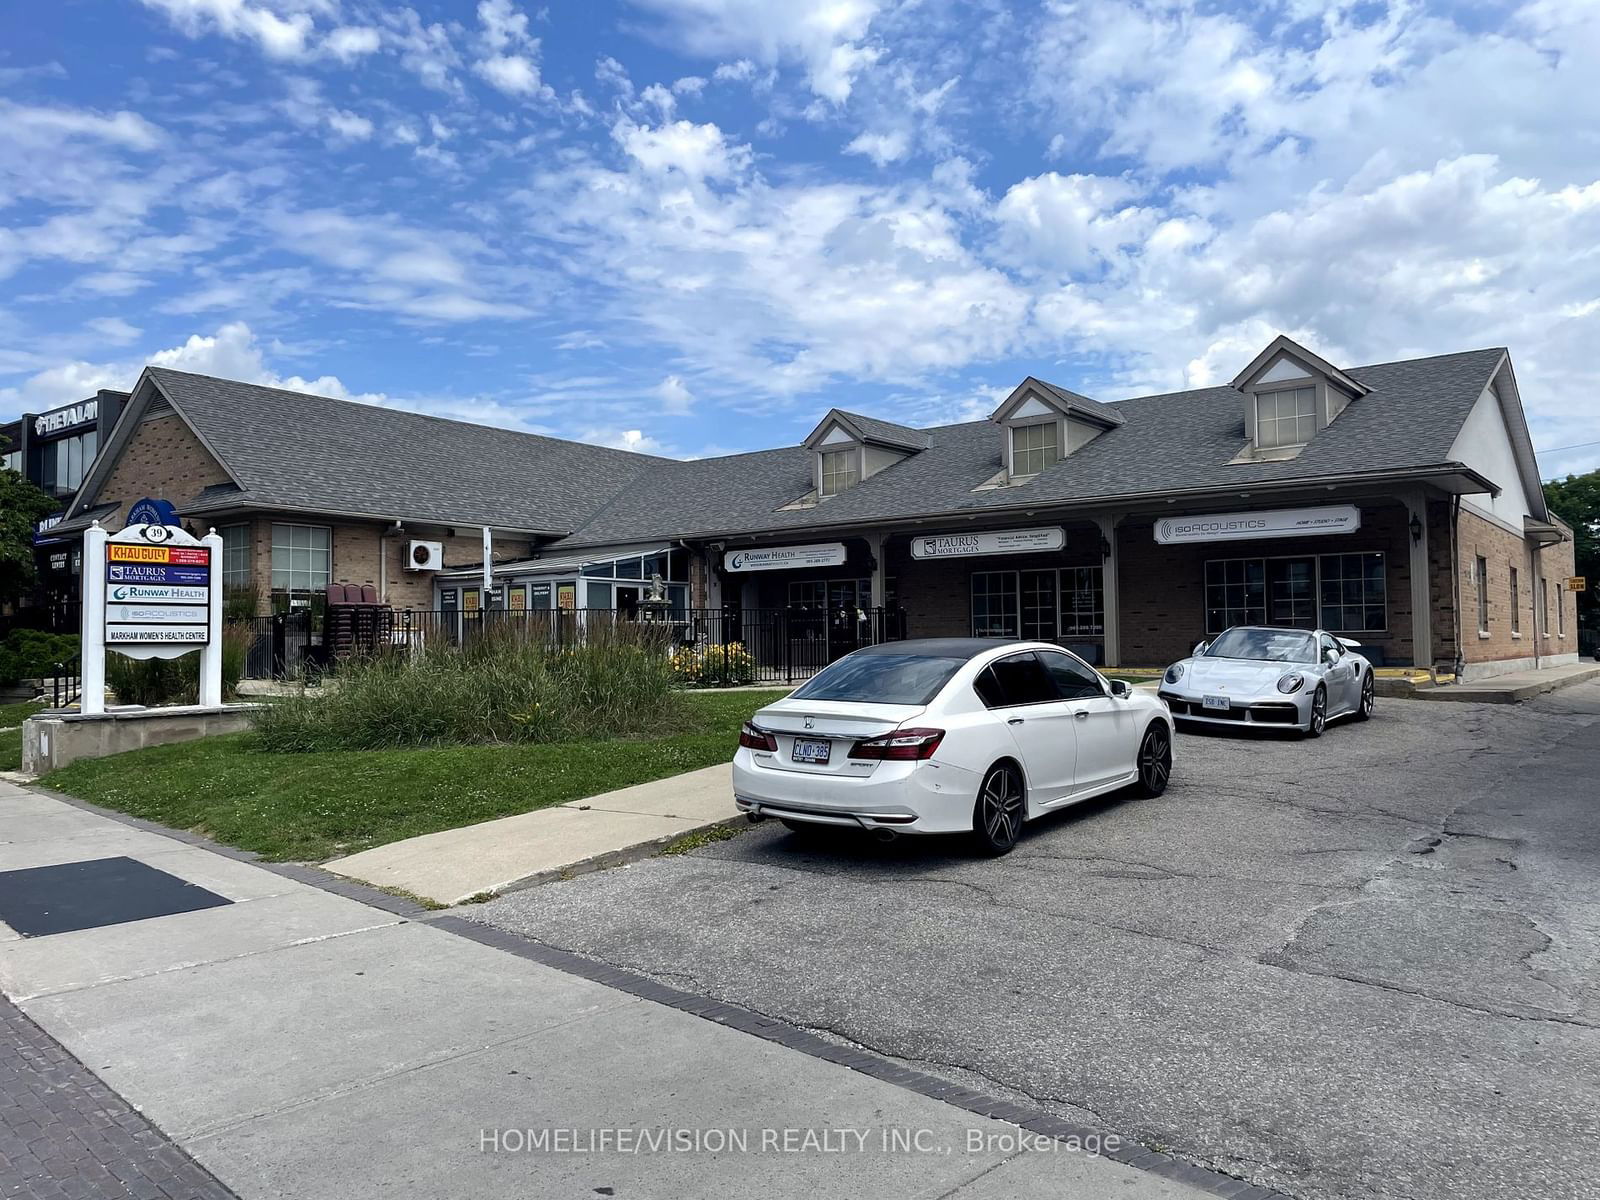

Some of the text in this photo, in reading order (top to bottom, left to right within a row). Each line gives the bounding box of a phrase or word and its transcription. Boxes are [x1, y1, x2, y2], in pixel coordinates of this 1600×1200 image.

[151, 528, 162, 538] 39
[937, 536, 979, 546] TAURUS
[113, 547, 167, 560] KHAU GULLY
[937, 546, 979, 554] MORTGAGES
[50, 552, 67, 561] CONTACT
[744, 552, 770, 561] RUNWAY
[772, 551, 795, 560] HEALTH
[124, 566, 166, 576] TAURUS
[130, 587, 205, 598] RUNWAY HEALTH
[110, 631, 205, 640] MARKHAM WOMEN'S HEALTH CENTRE
[816, 745, 829, 758] 385
